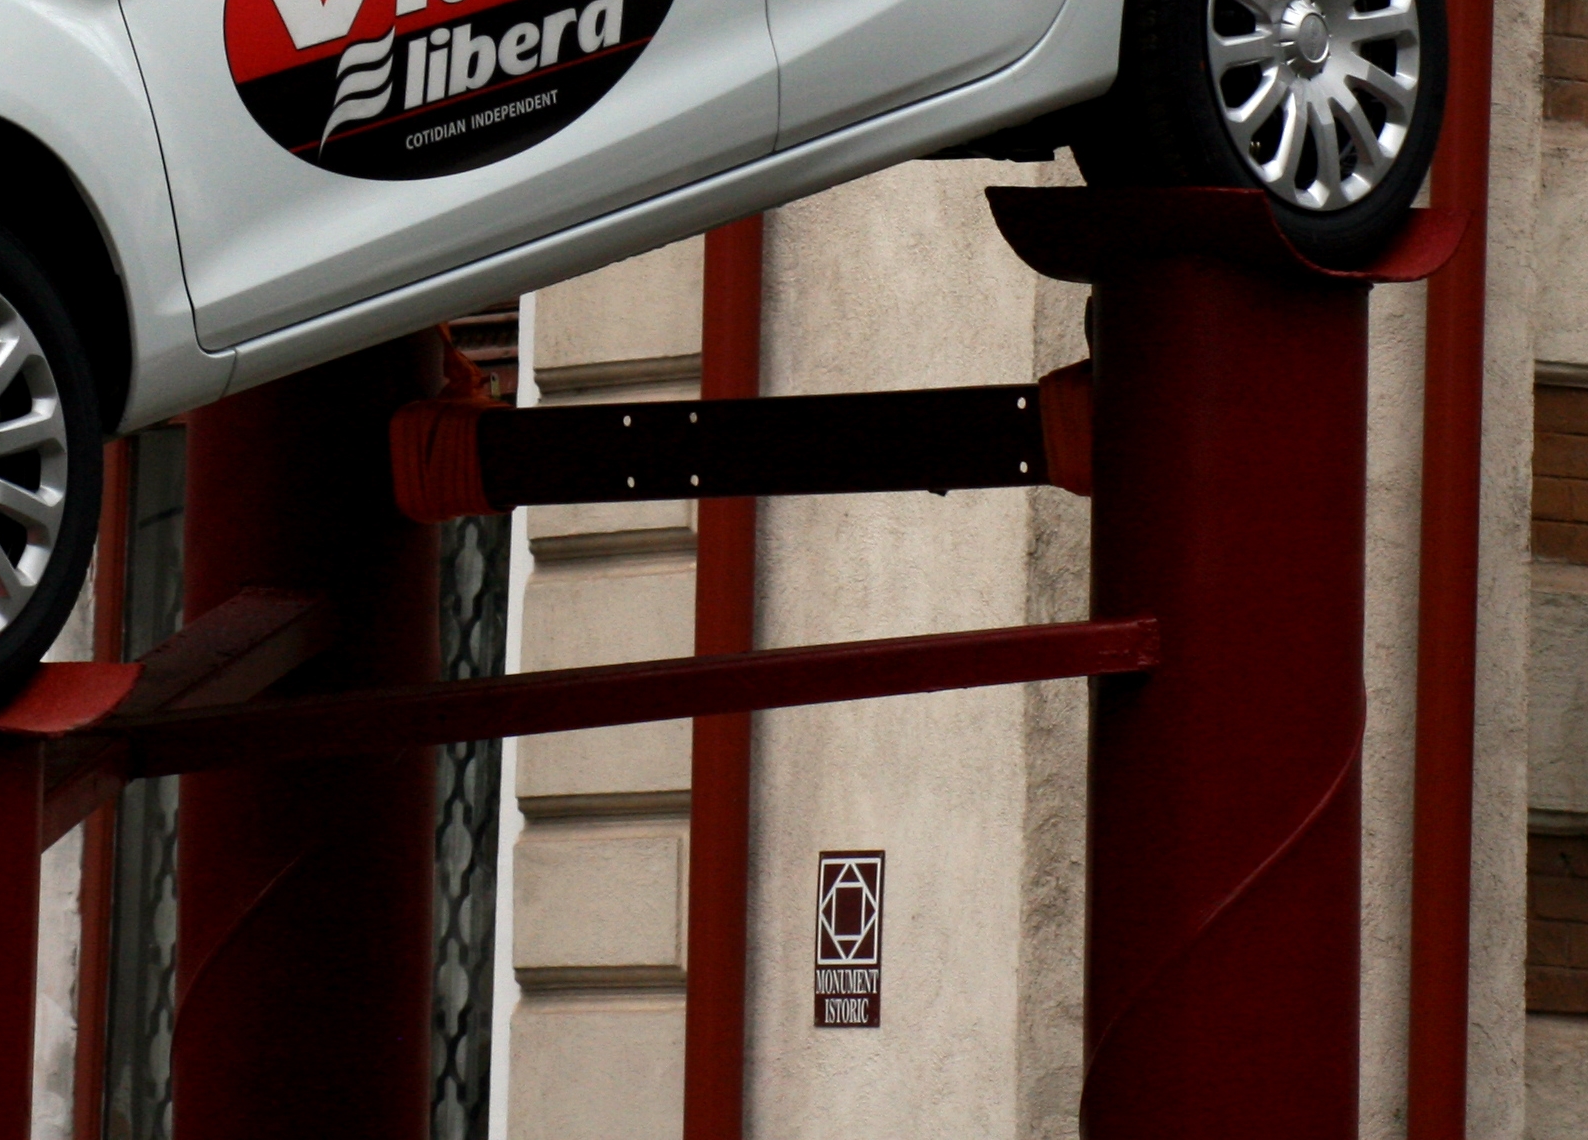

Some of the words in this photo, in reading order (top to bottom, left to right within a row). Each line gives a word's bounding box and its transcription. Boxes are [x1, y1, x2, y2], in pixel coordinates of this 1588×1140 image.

[405, 119, 466, 151] COTIDIAN
[470, 89, 559, 130] INDEPENDENT
[816, 969, 879, 995] MONUMENT
[824, 997, 869, 1023] ISTORIC
